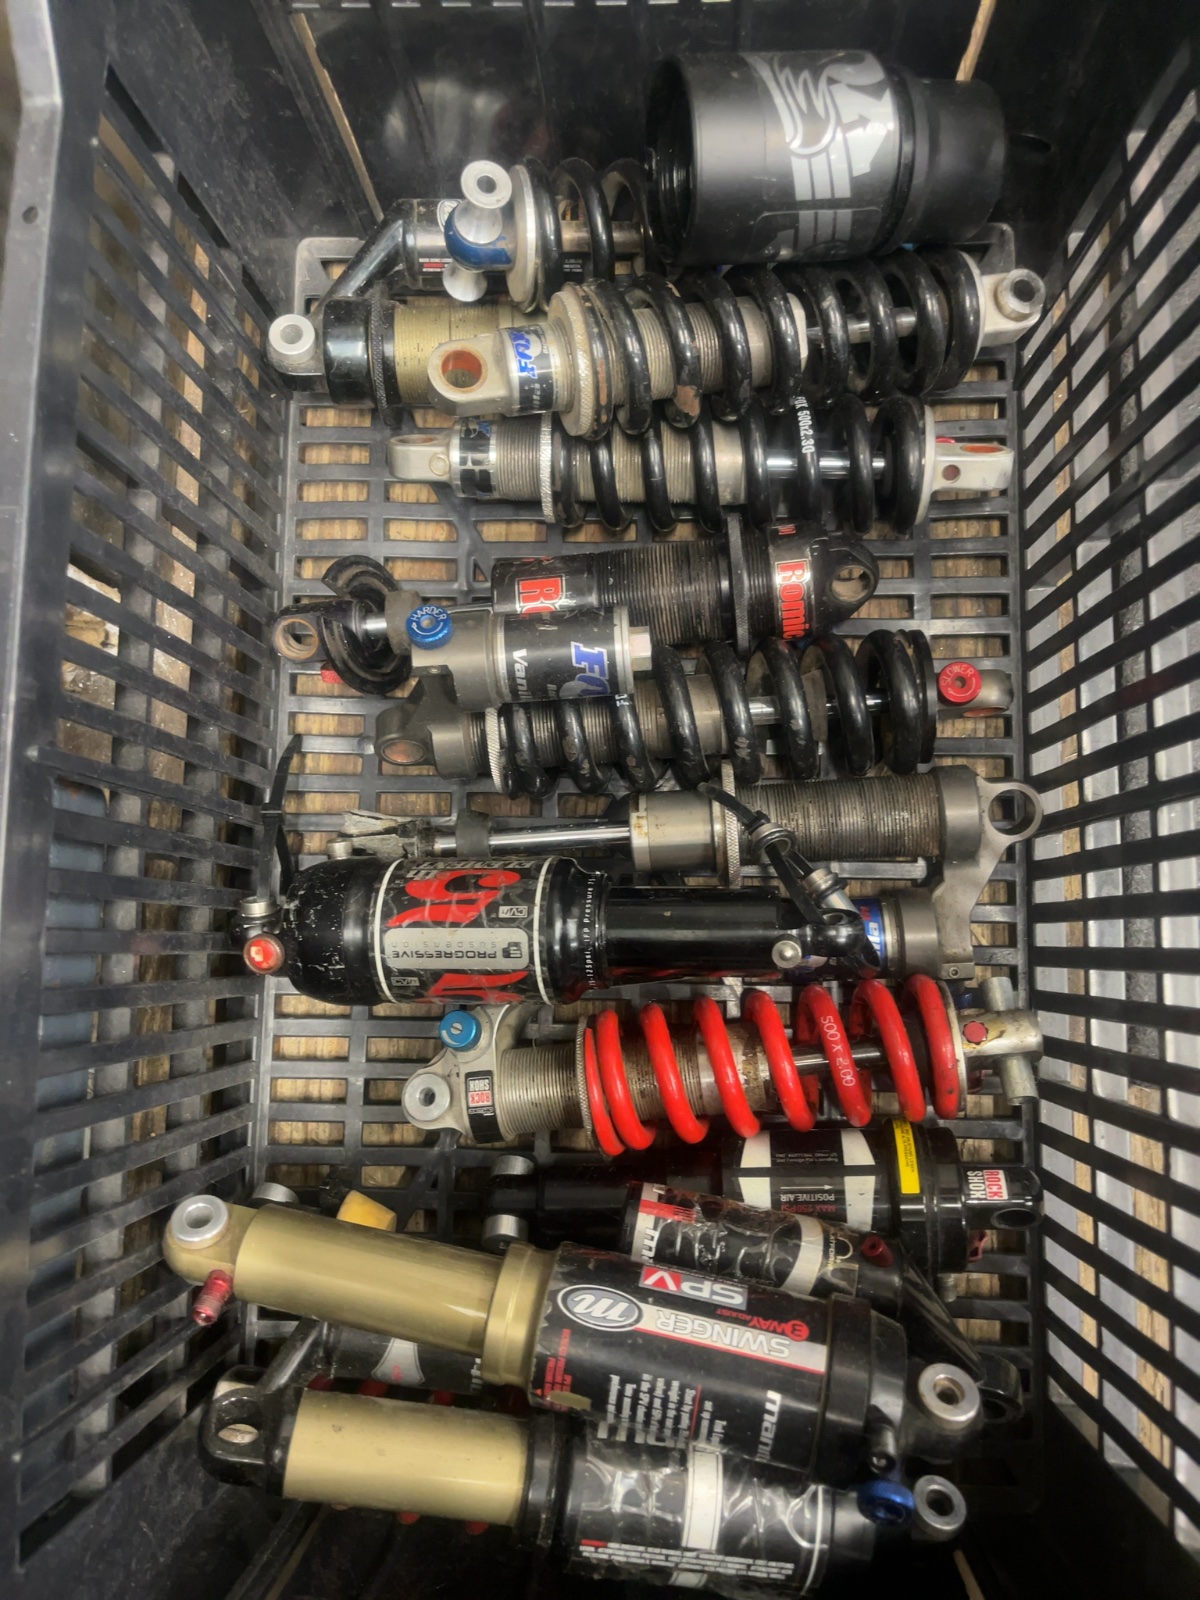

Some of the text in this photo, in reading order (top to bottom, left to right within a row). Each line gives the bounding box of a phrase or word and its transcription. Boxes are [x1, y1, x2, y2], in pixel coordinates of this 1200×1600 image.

[797, 410, 815, 454] 500x2.30
[410, 606, 447, 621] HARDER
[776, 561, 810, 639] Romic
[513, 648, 533, 699] Vanil
[571, 641, 610, 697] FO
[941, 664, 974, 686] SLOWER
[583, 888, 594, 923] Pressure
[583, 927, 591, 942] IFP
[391, 950, 498, 959] PROGRESSIVE
[821, 1015, 840, 1041] 500
[836, 1058, 856, 1087] 2.00
[469, 1080, 490, 1092] SHOX
[470, 1092, 491, 1104] ROCK
[779, 1192, 836, 1202] POSITIVE AIR
[967, 1170, 986, 1199] SHOX
[985, 1170, 1004, 1199] ROCK
[815, 1203, 836, 1213] MAX
[643, 1270, 744, 1305] SPV
[715, 1307, 750, 1322] ADJUST
[655, 1309, 791, 1358] SWINGER
